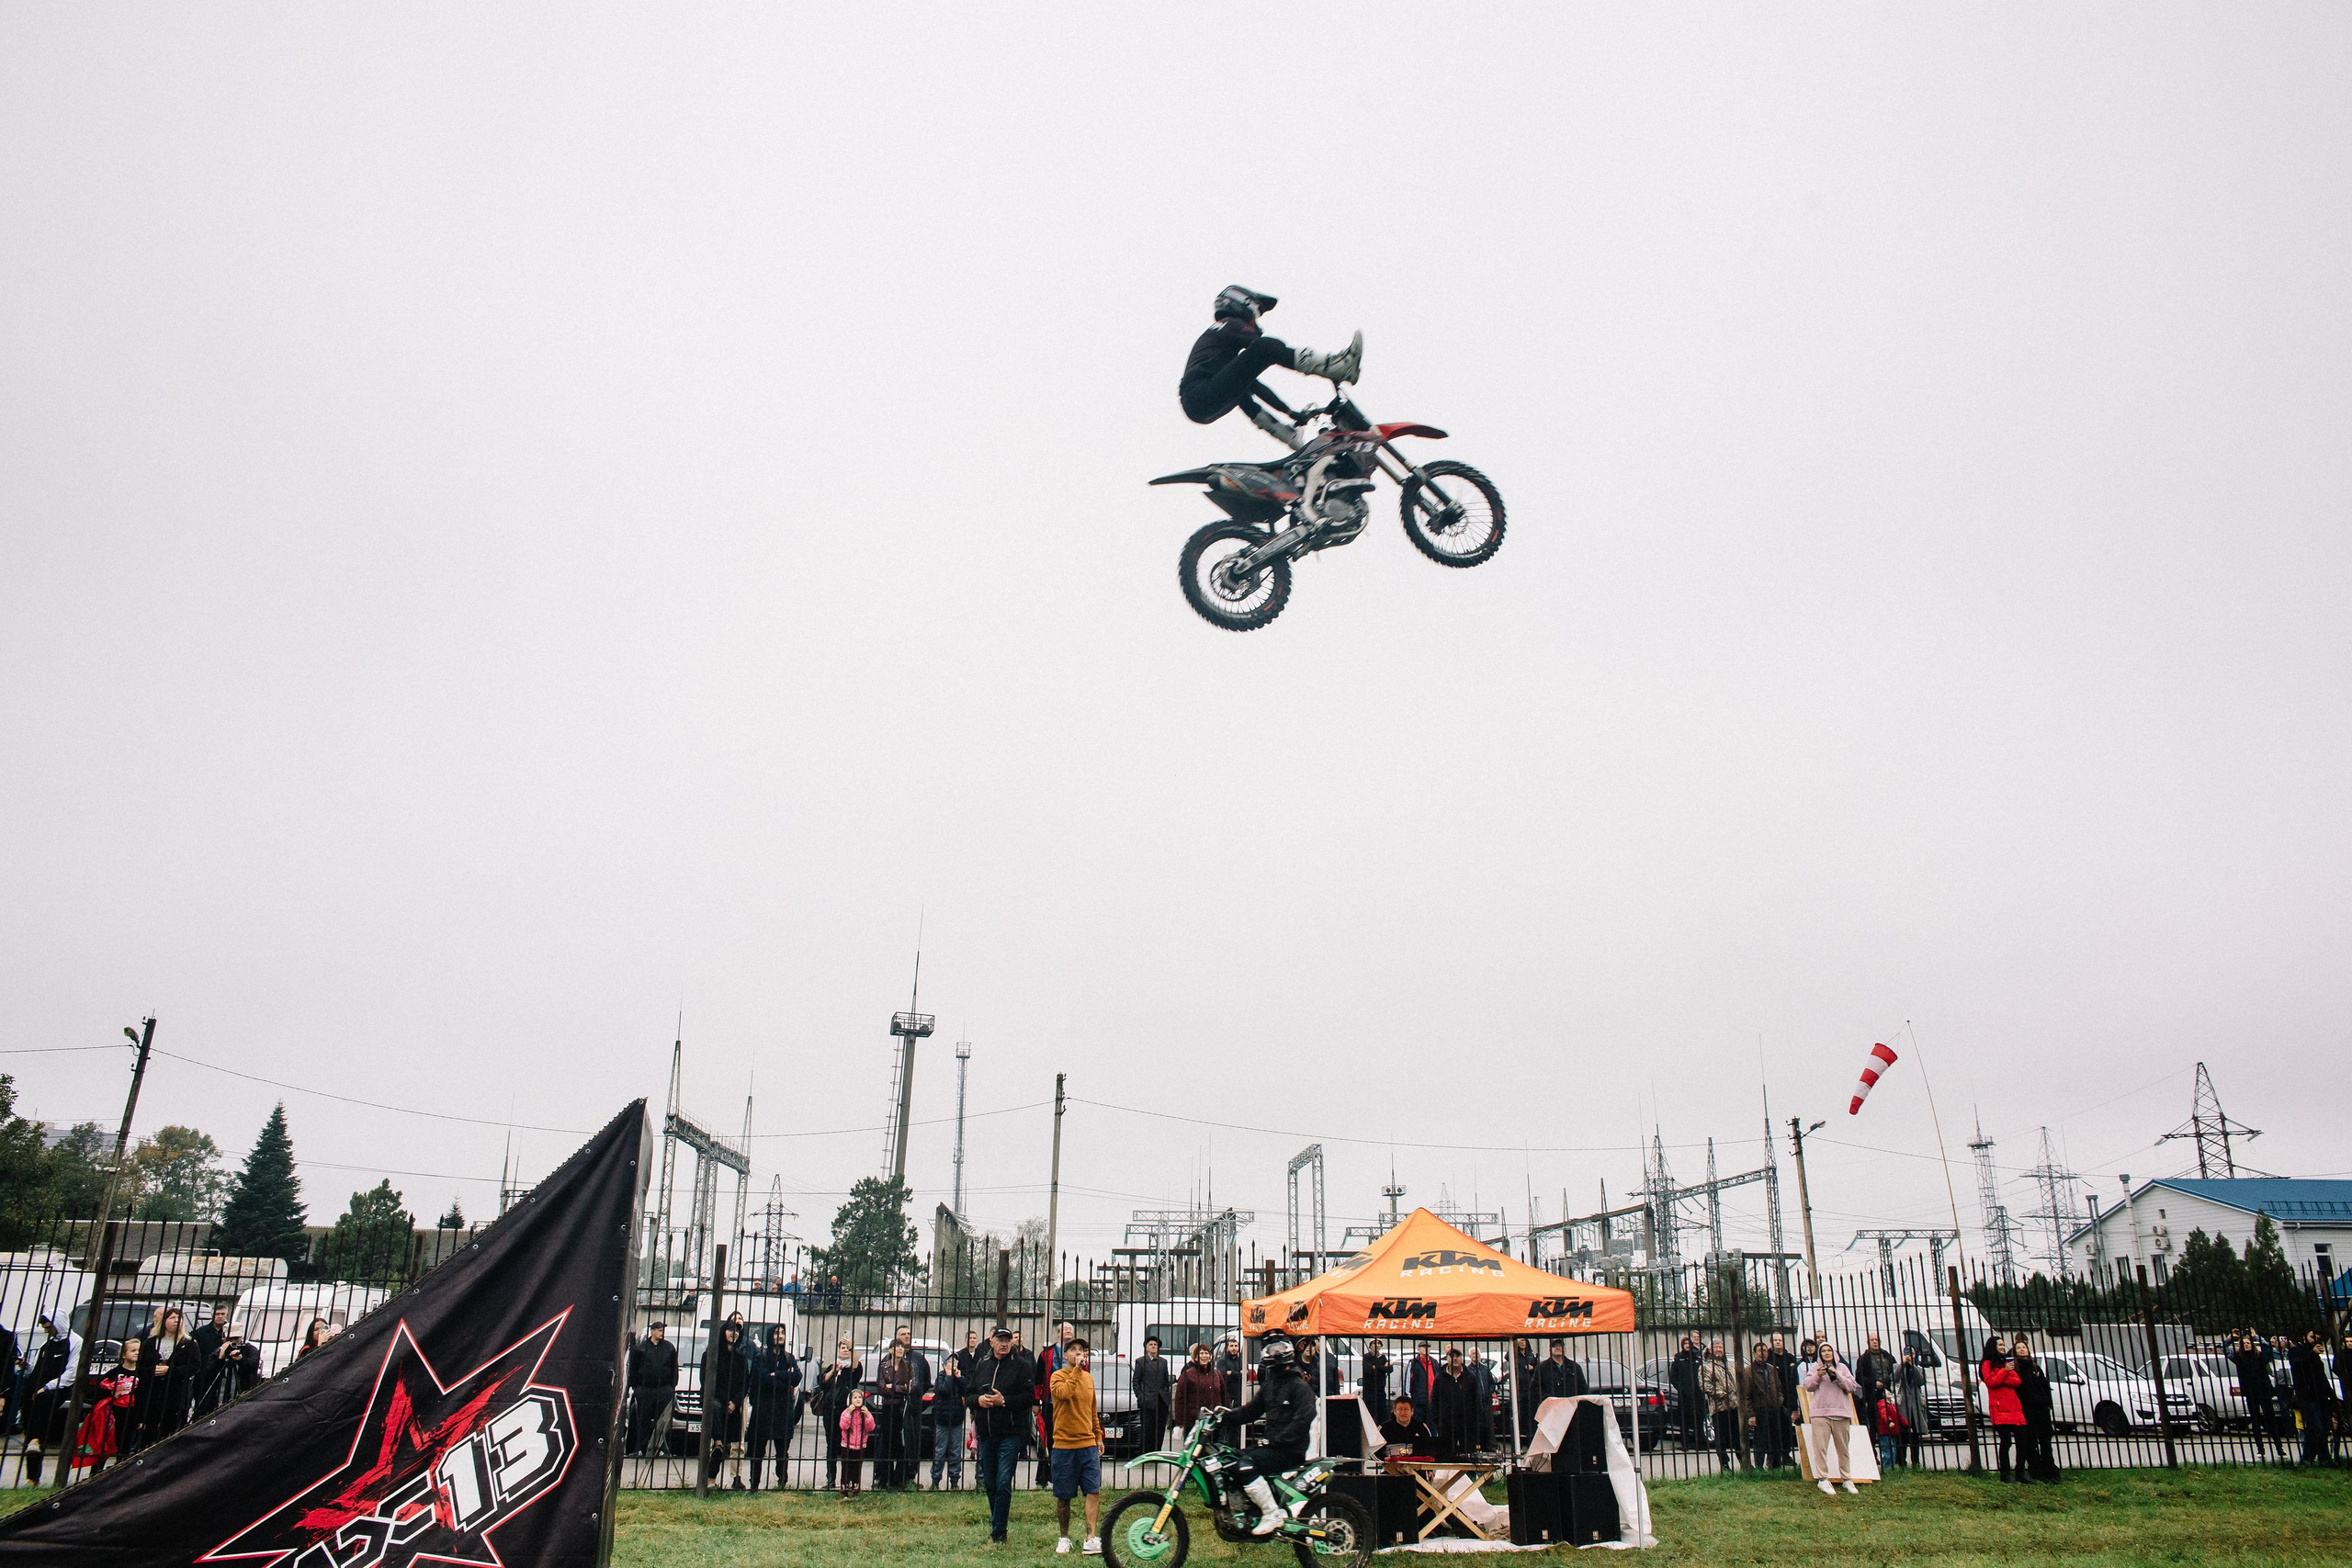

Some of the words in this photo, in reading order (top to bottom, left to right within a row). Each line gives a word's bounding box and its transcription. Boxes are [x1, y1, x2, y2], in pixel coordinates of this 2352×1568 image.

[1402, 1250, 1502, 1270] KTM
[1368, 1297, 1437, 1318] KTM
[1528, 1297, 1593, 1317] KTM
